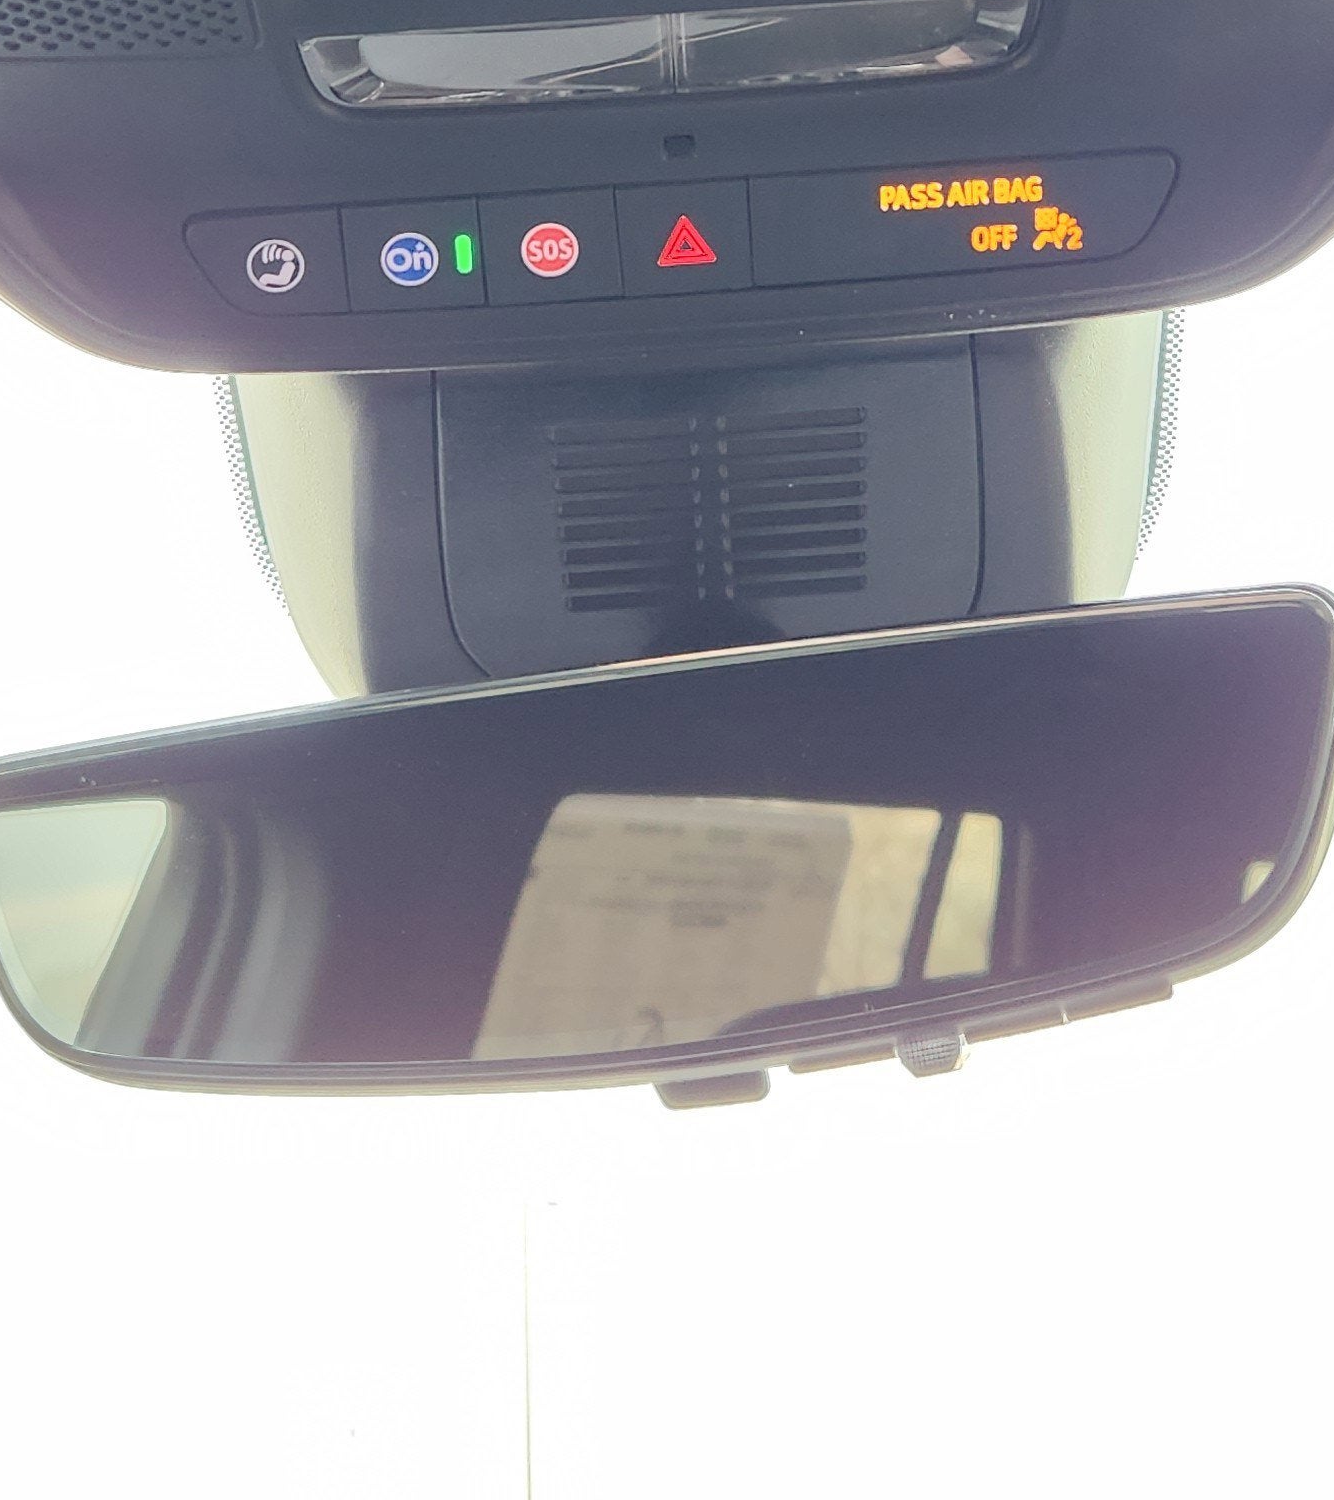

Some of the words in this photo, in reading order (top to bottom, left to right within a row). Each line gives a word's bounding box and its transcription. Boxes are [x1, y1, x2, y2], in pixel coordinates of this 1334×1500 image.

[879, 182, 944, 212] PASS
[946, 180, 990, 208] AIR
[993, 175, 1043, 204] BAG
[527, 238, 573, 263] SOS
[971, 224, 1017, 252] OFF
